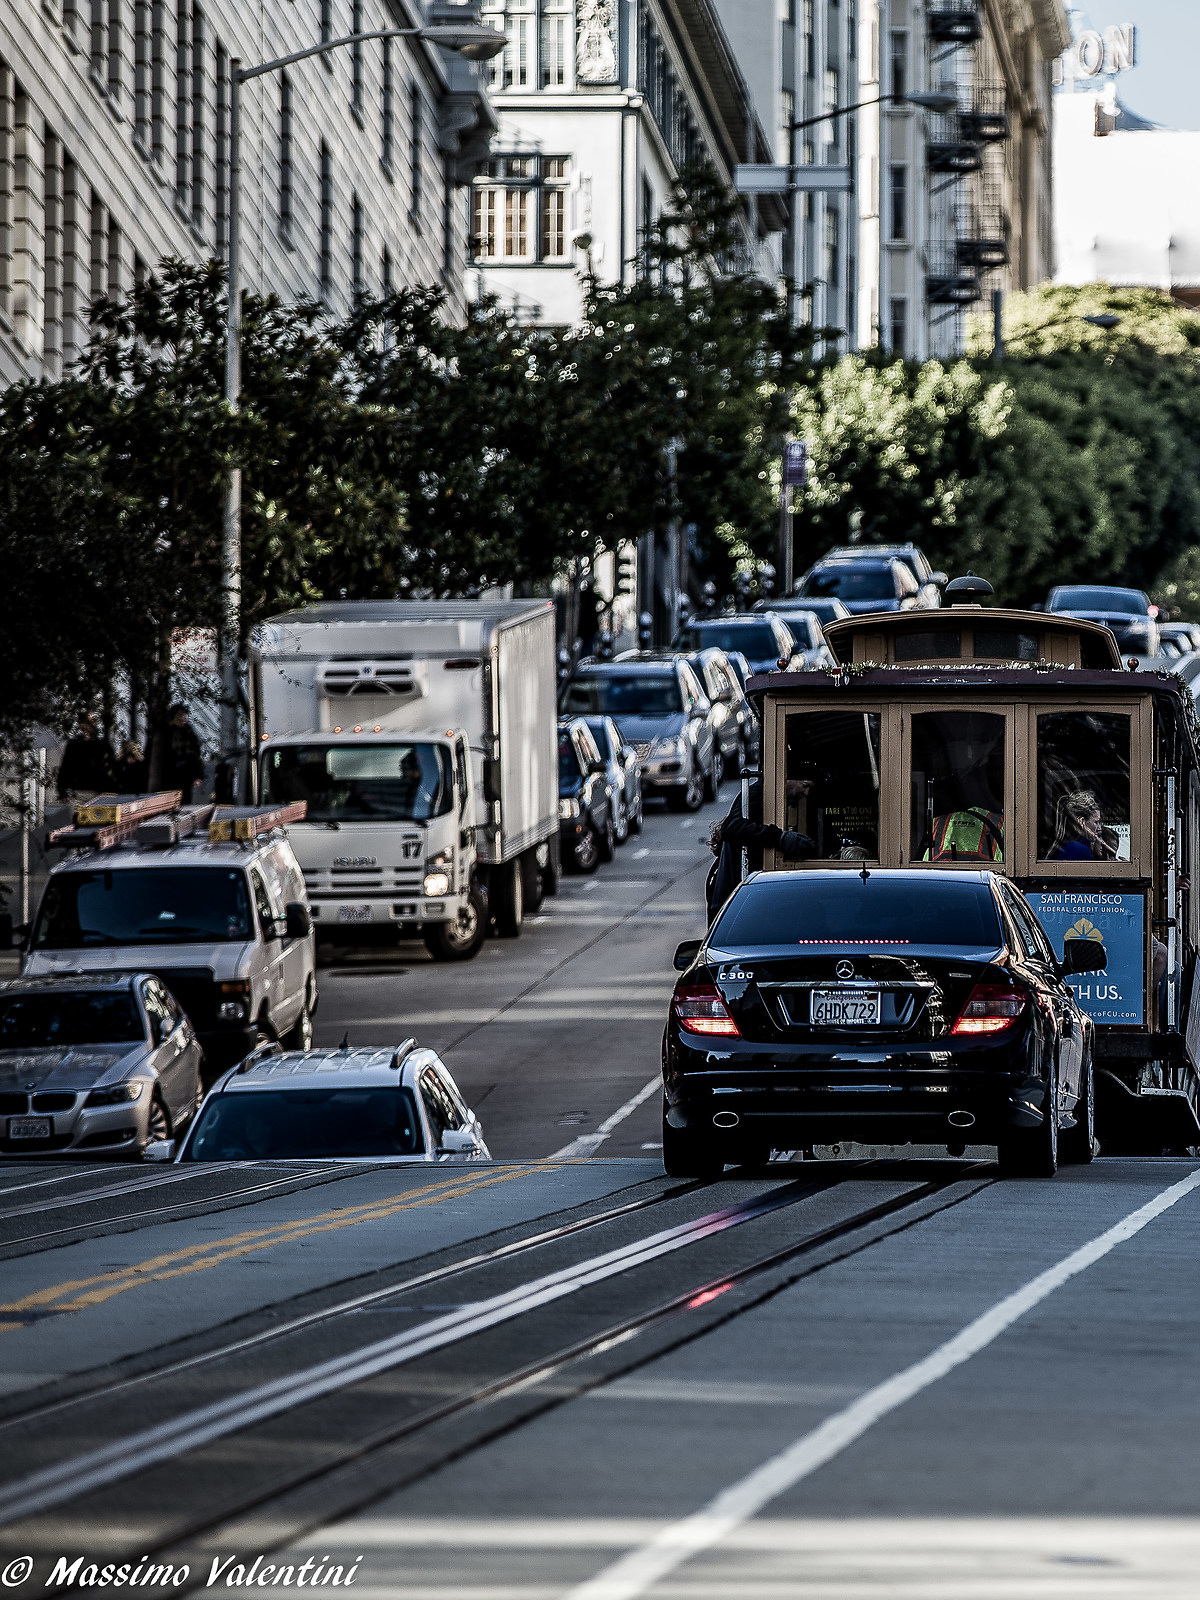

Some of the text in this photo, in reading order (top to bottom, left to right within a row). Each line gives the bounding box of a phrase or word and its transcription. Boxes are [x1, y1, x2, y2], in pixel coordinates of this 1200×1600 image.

[401, 841, 424, 859] 17
[1040, 894, 1122, 905] SAN FRANCISCO
[1068, 984, 1123, 1000] TH US.
[816, 1002, 876, 1019] 6HDK729
